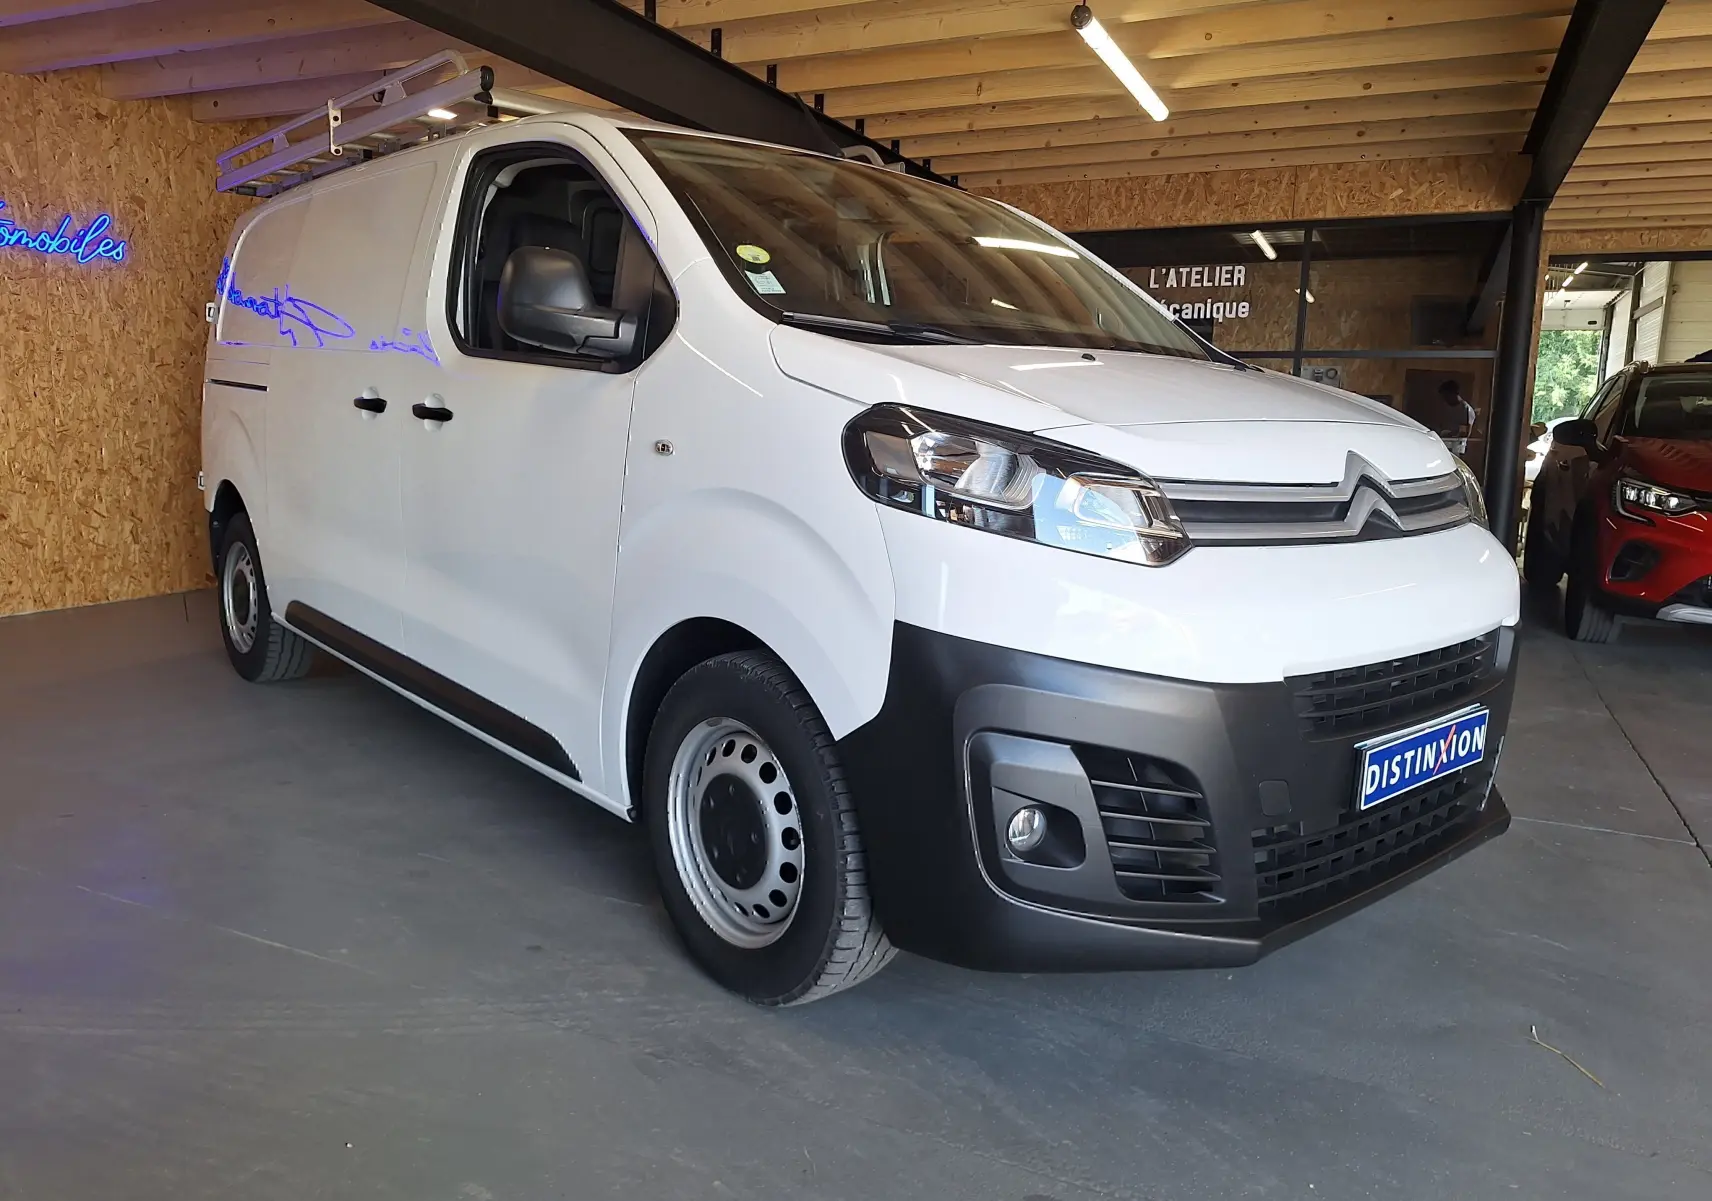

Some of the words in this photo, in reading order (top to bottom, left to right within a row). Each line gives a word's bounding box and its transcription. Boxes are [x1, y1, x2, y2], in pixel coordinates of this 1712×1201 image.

[0, 203, 126, 264] omobiles
[1149, 265, 1246, 289] L'ATELIER
[1365, 724, 1486, 796] DISTINXION
